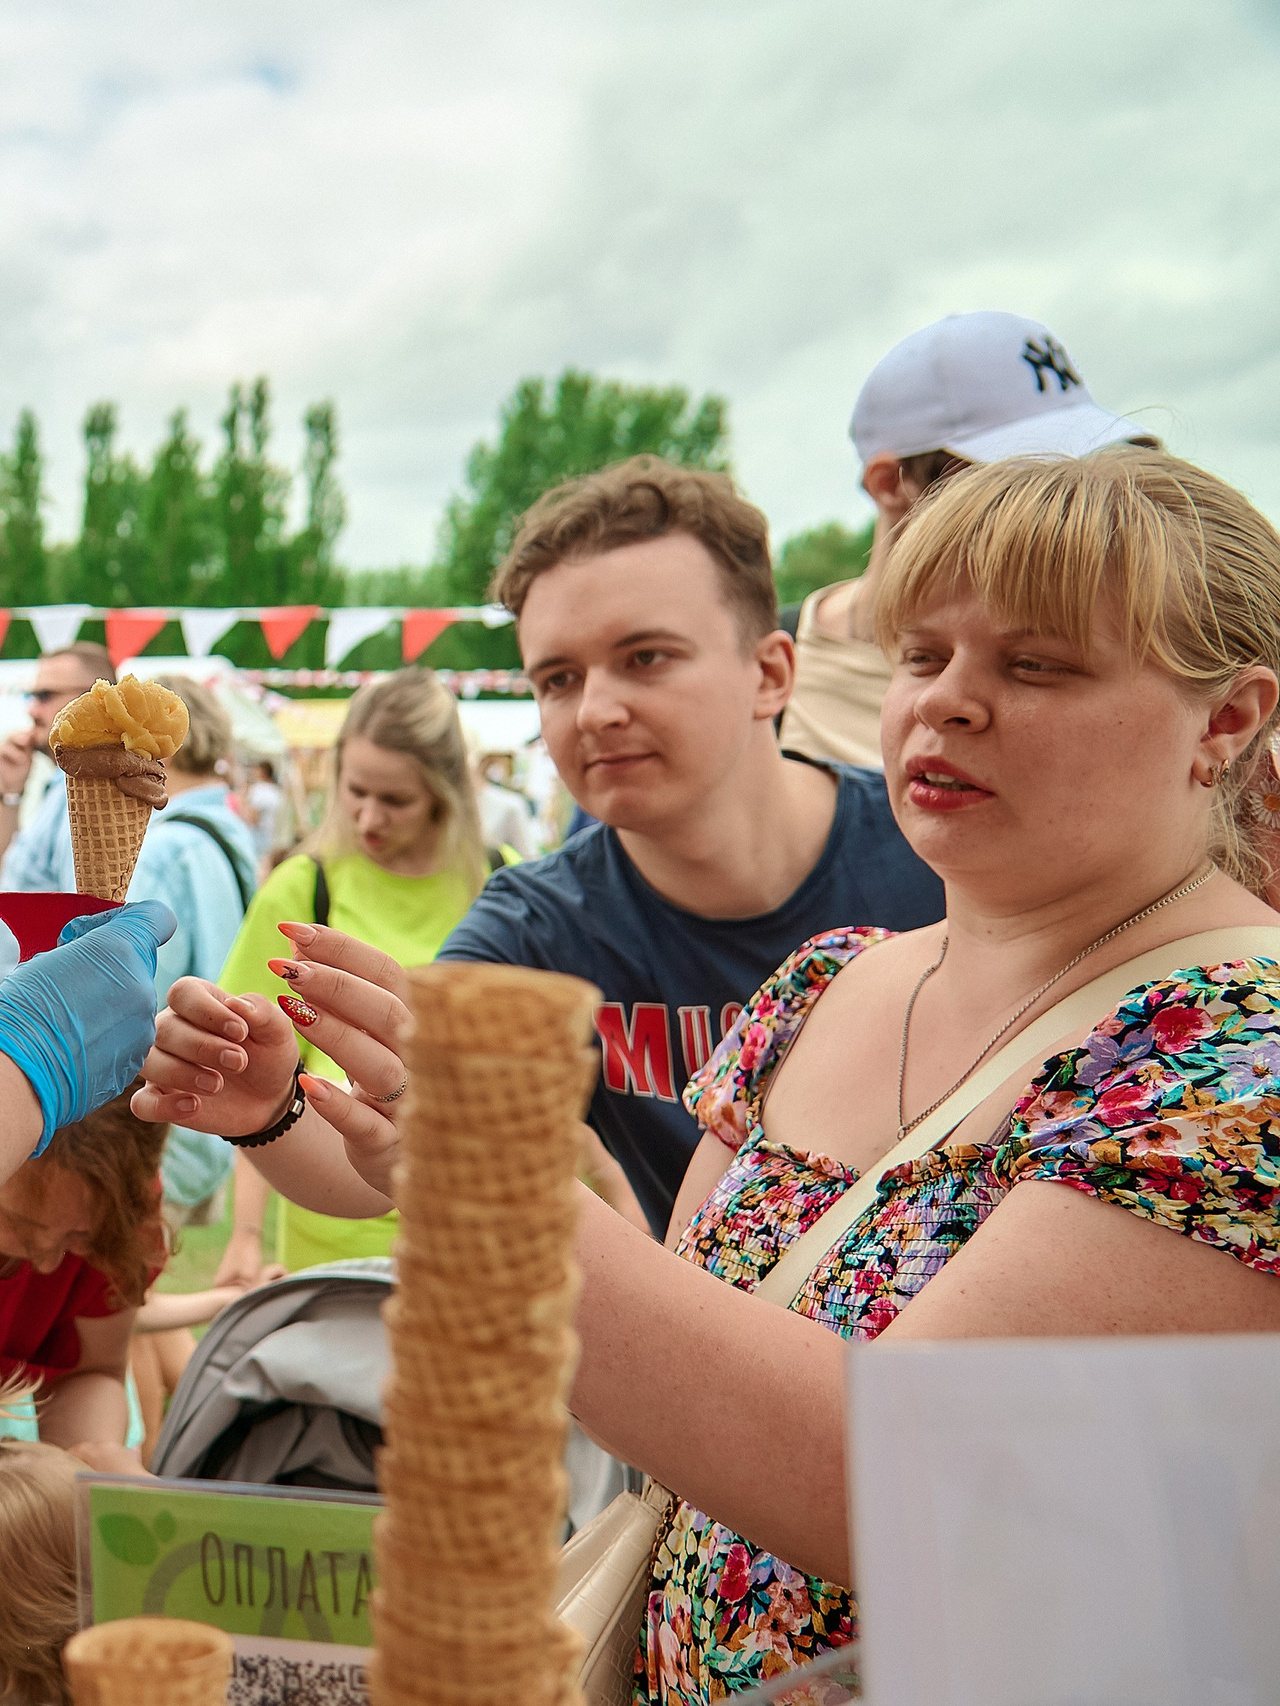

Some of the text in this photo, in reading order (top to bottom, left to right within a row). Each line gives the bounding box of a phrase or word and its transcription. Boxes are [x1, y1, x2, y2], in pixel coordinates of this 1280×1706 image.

[1022, 336, 1081, 392] NY
[593, 1001, 744, 1103] MU
[200, 1531, 373, 1617] ОПЛАТА
